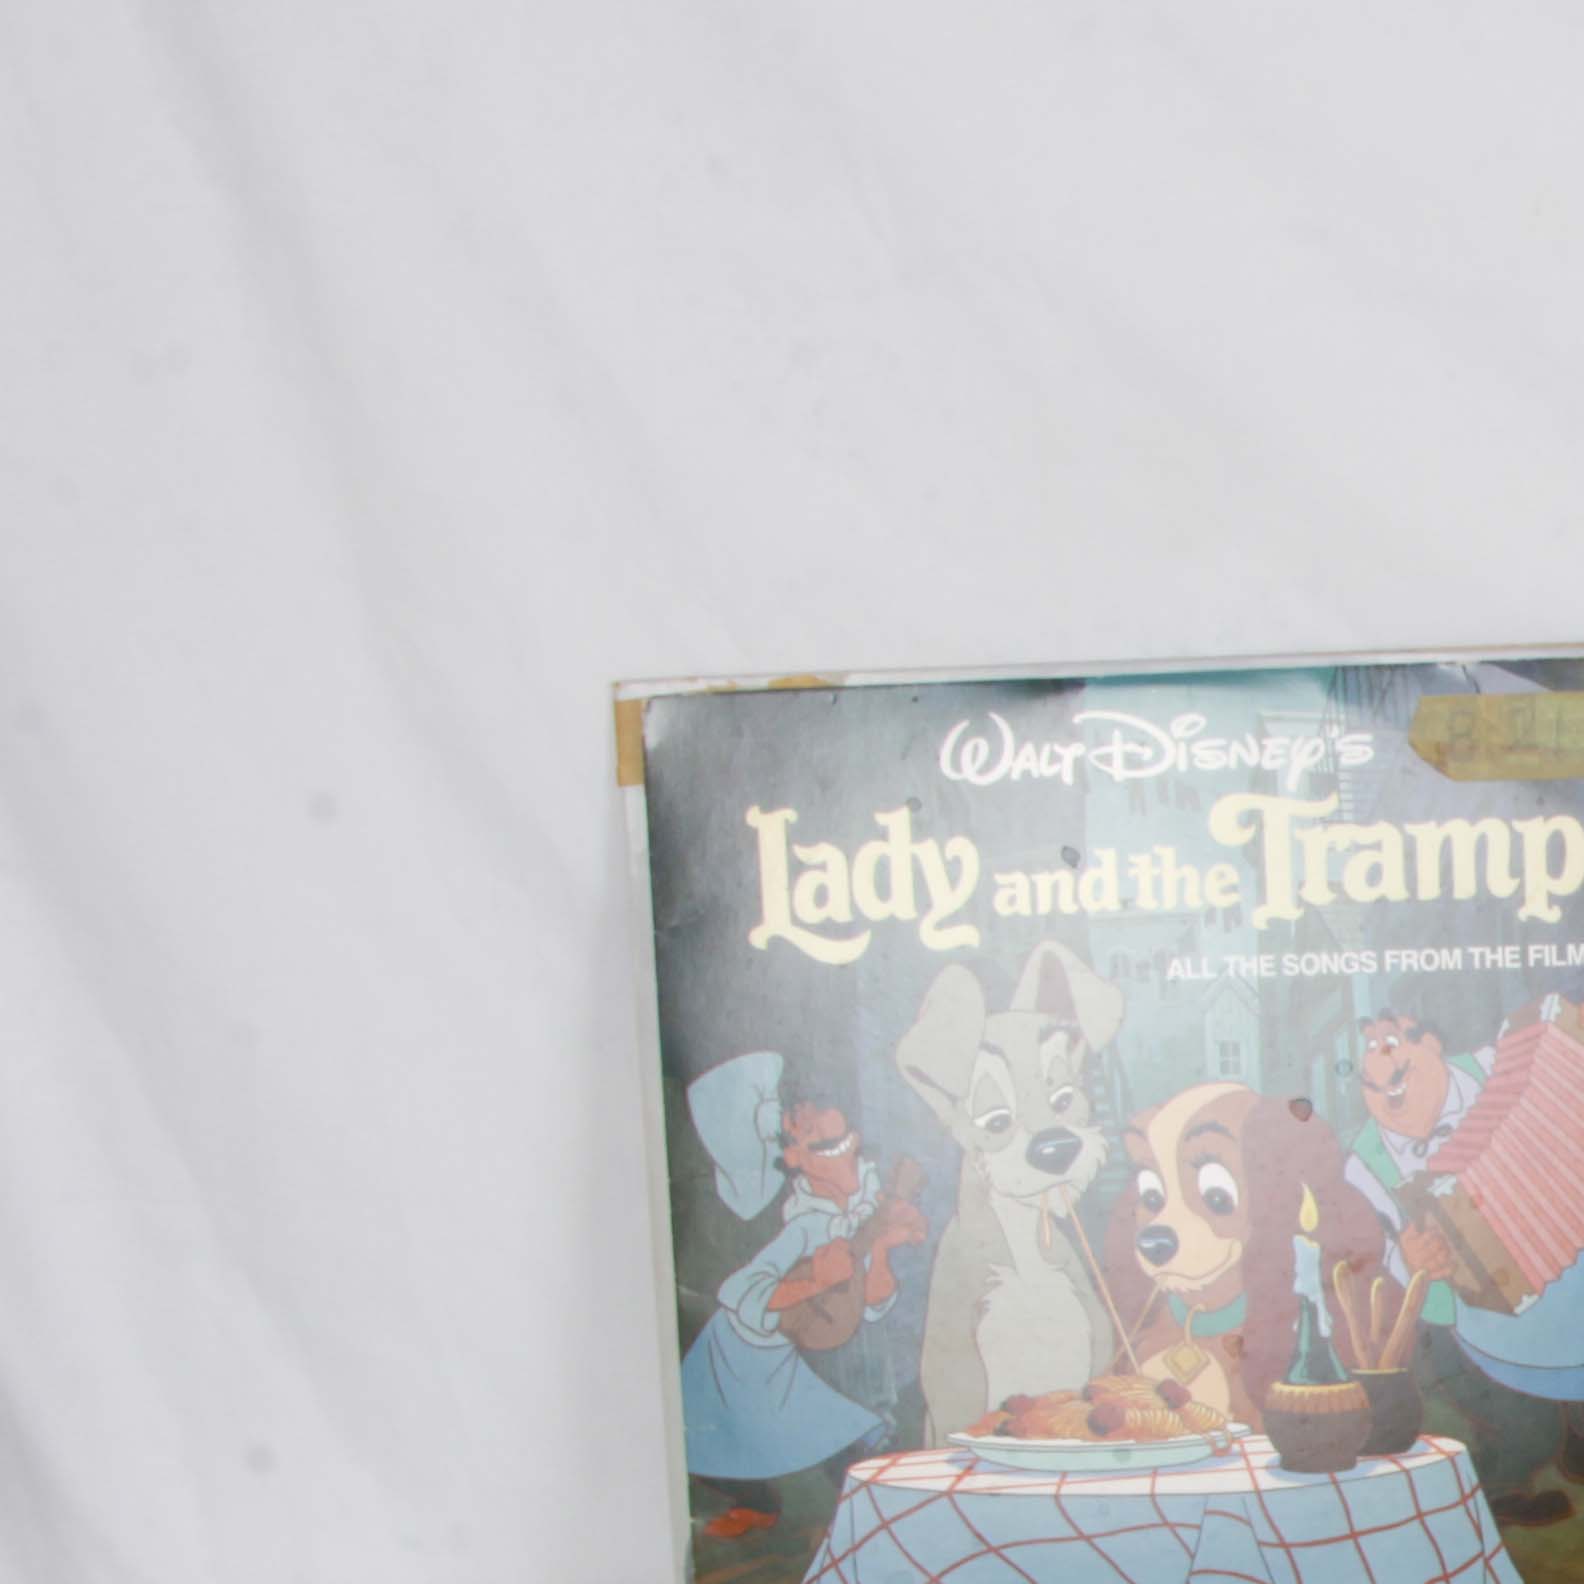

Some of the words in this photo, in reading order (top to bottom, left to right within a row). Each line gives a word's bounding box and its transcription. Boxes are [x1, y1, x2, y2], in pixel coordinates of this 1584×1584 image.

[744, 804, 981, 966] Lady
[992, 846, 1121, 918] and
[1127, 844, 1242, 913] the
[1166, 957, 1219, 981] ALL
[1224, 955, 1276, 978] THE
[1282, 950, 1378, 977] SONGS
[1384, 947, 1462, 973] FROM
[1469, 946, 1522, 970] THE
